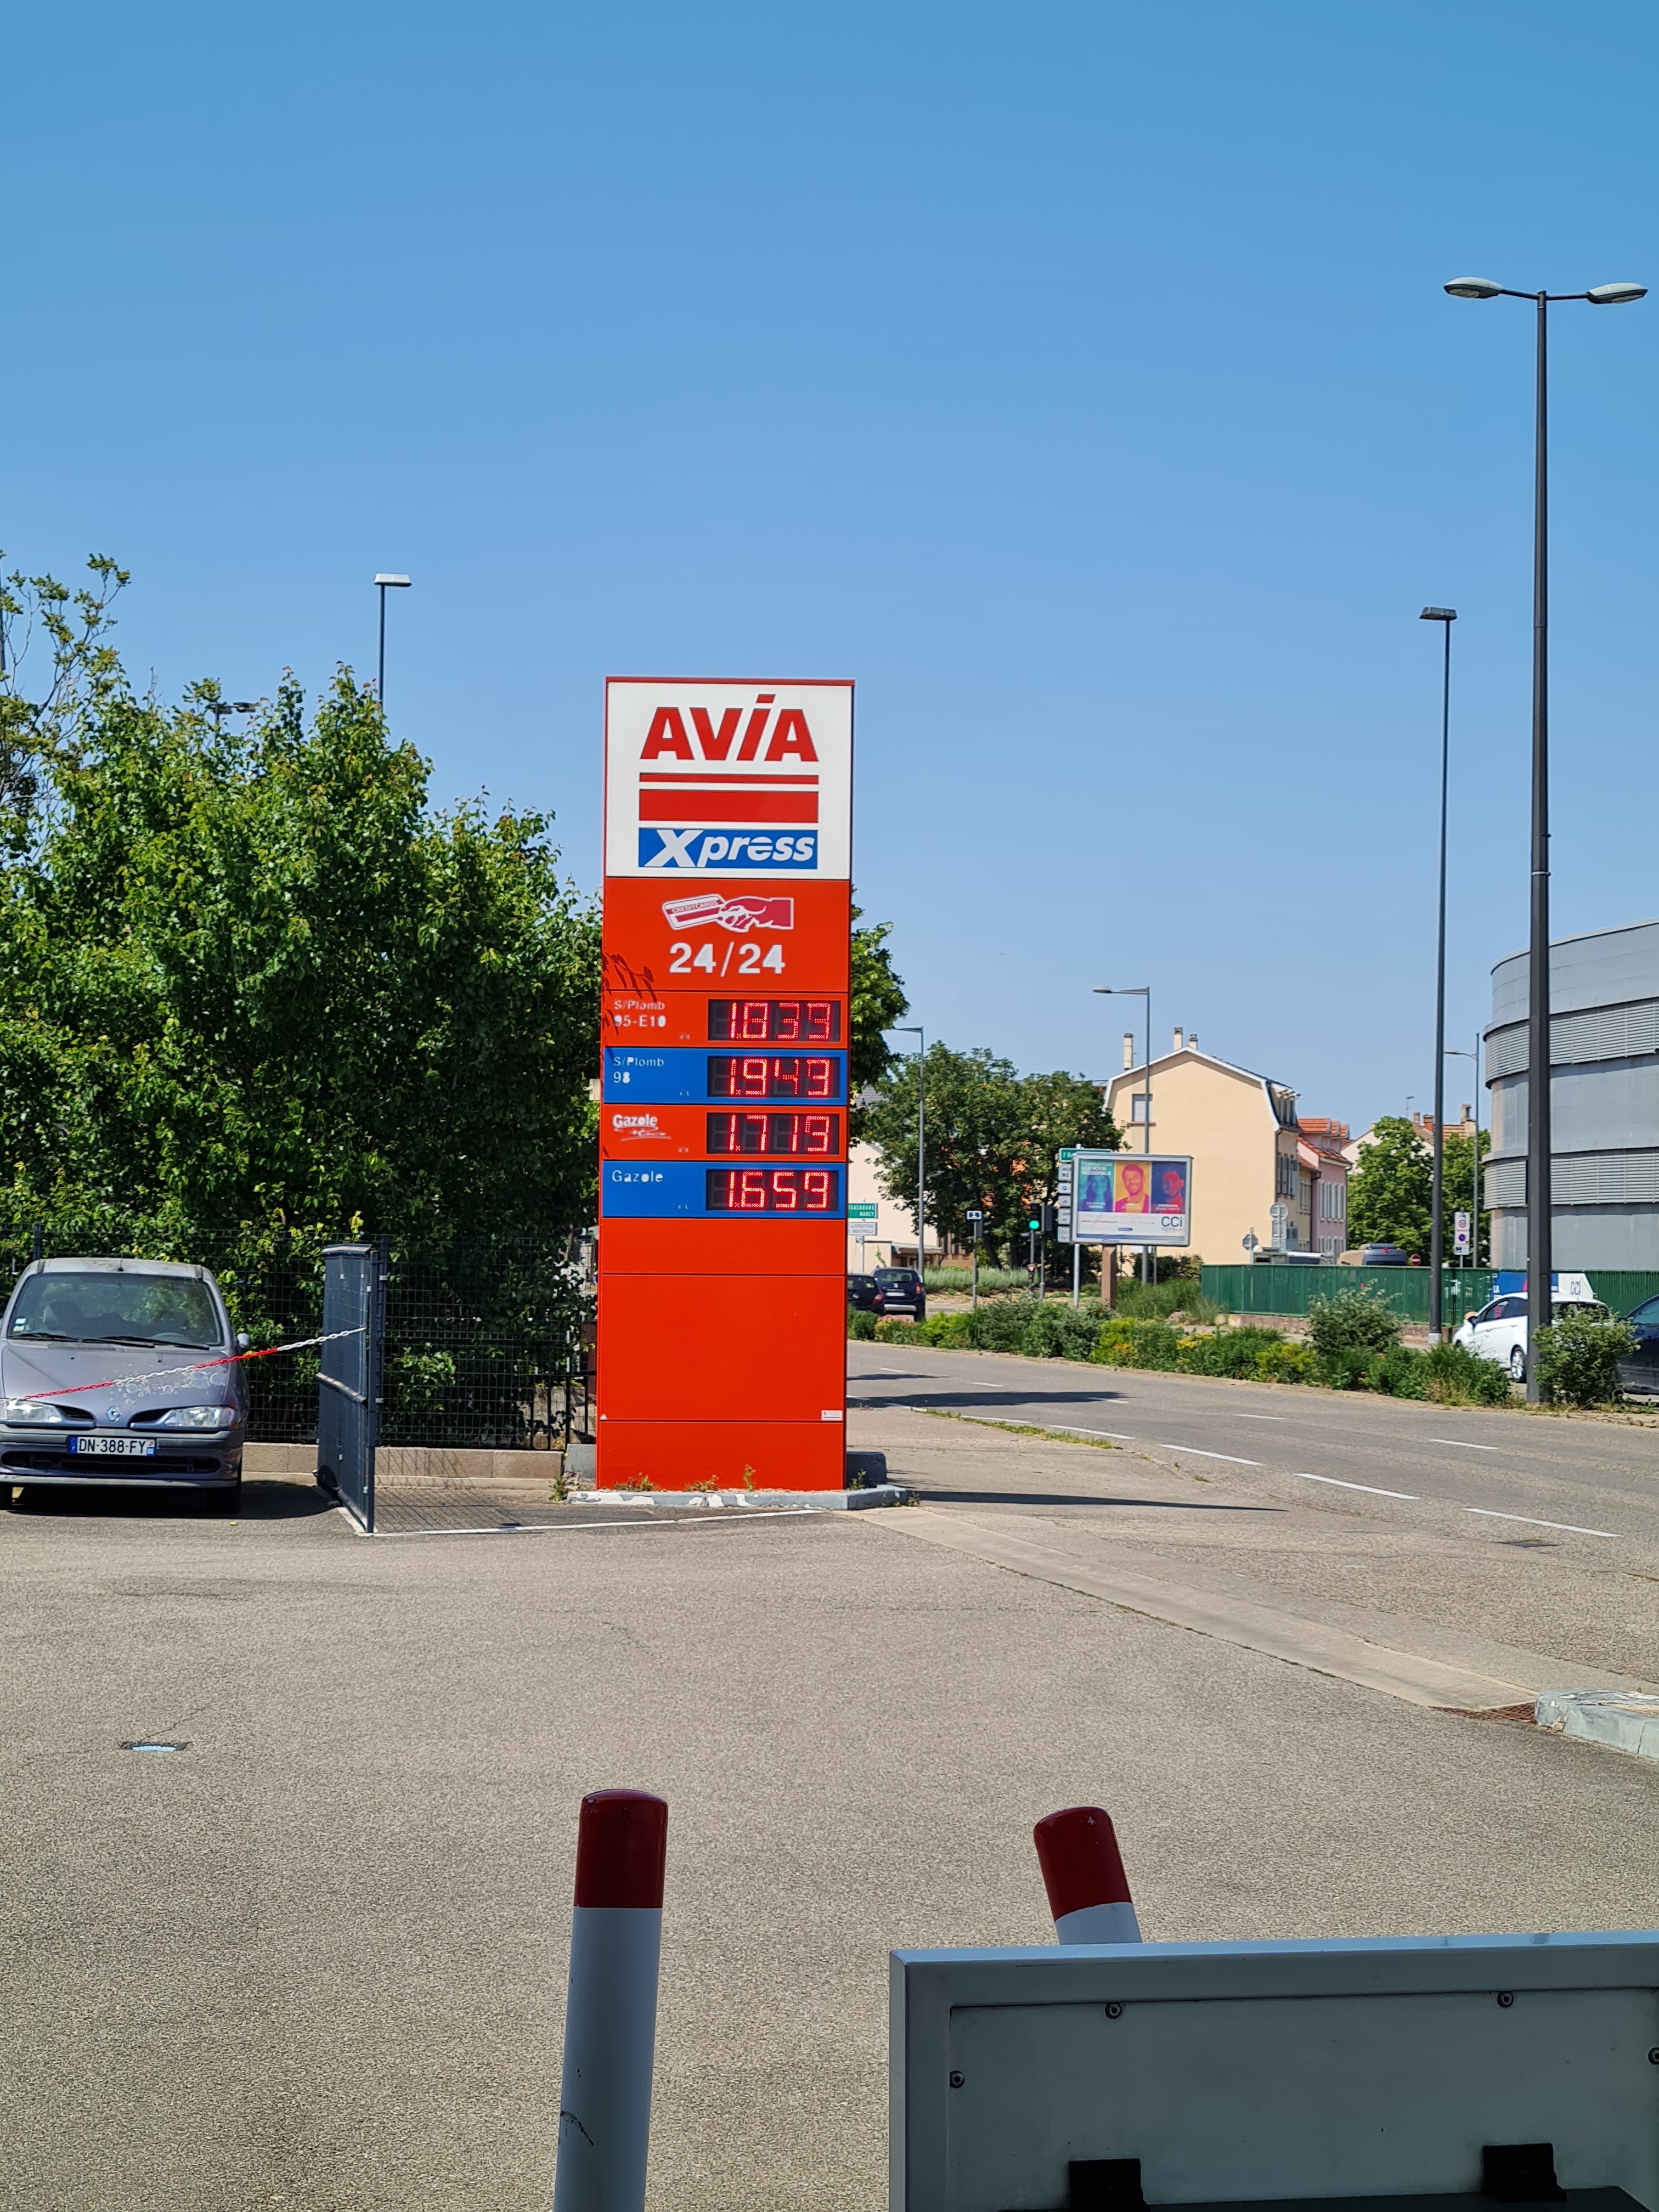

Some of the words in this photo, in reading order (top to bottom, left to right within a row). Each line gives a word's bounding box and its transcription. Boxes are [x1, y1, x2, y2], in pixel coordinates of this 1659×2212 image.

[644, 829, 815, 867] Xpress
[669, 941, 786, 977] 24/24
[613, 999, 665, 1011] S/Plomb
[613, 1014, 667, 1028] 95-E10
[730, 1002, 831, 1039] 1.839
[613, 1056, 664, 1067] S/Plomb
[613, 1071, 630, 1084] 98
[729, 1058, 830, 1096] 1.949
[612, 1113, 658, 1127] Gazole
[729, 1114, 830, 1152] 1.719
[612, 1169, 664, 1182] Gazole
[728, 1170, 829, 1209] 1.659
[79, 1438, 146, 1454] DN-388-FY
